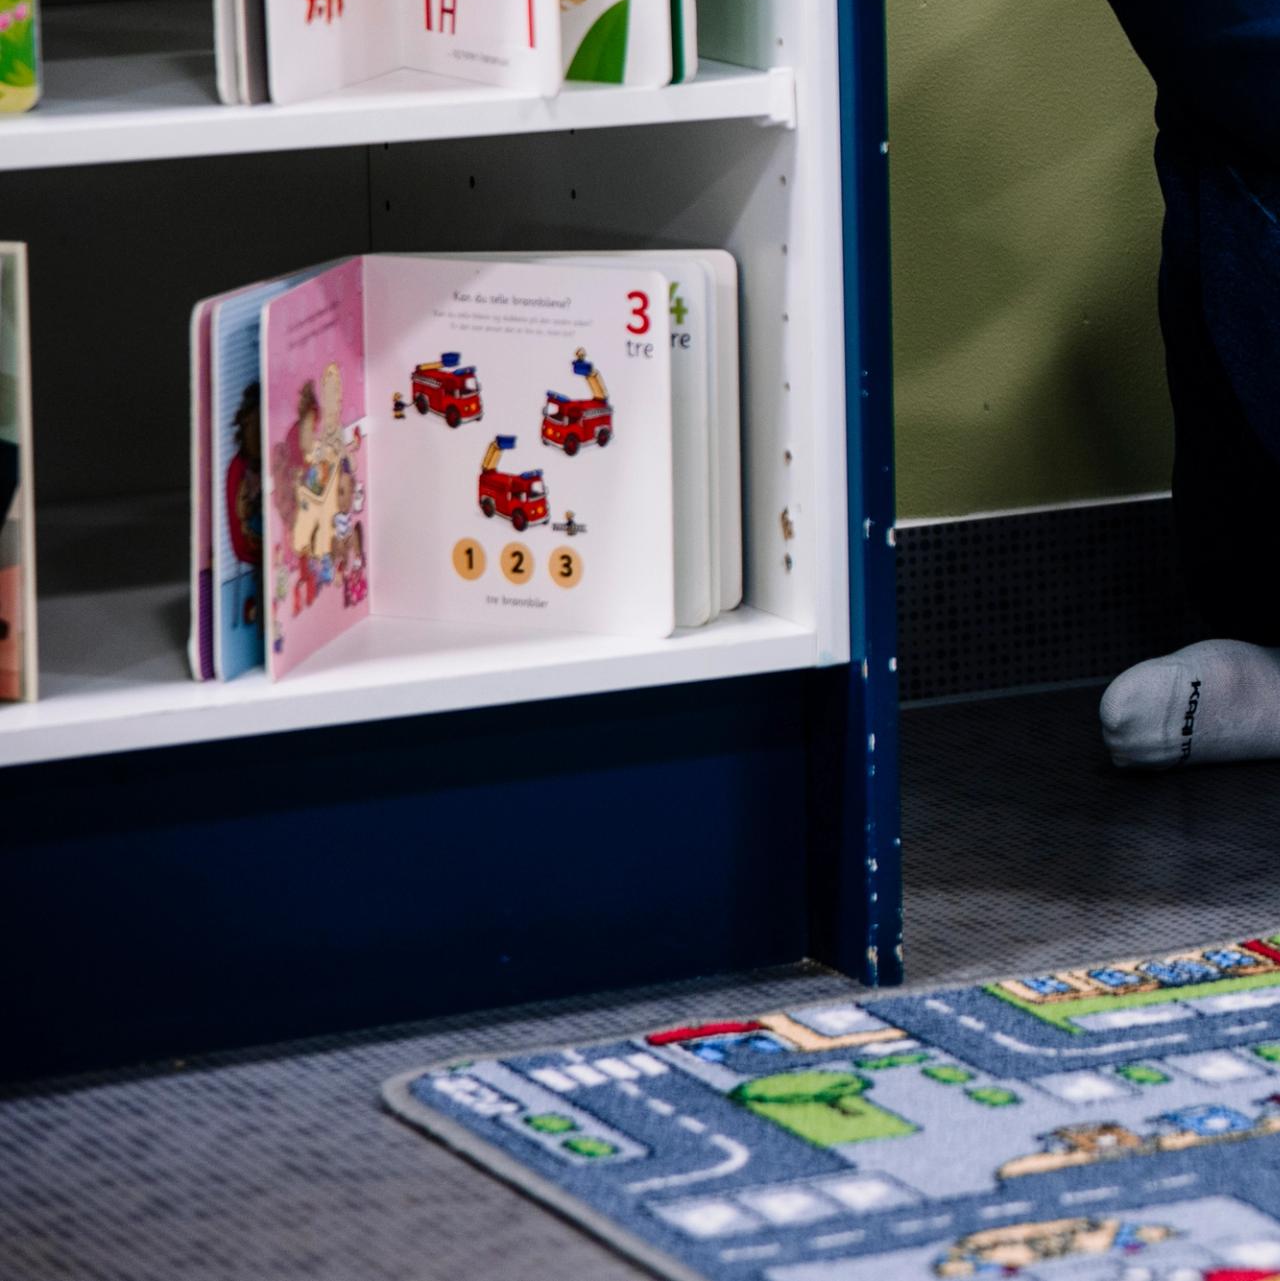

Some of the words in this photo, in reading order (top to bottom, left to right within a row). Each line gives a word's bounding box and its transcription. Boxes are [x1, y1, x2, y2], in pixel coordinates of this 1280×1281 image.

[626, 290, 651, 335] 3
[625, 339, 655, 360] tre
[670, 332, 692, 350] re
[465, 548, 474, 570] 1
[511, 550, 524, 573] 2
[559, 554, 573, 577] 3
[1182, 681, 1201, 736] KARI
[1181, 738, 1192, 761] TR
